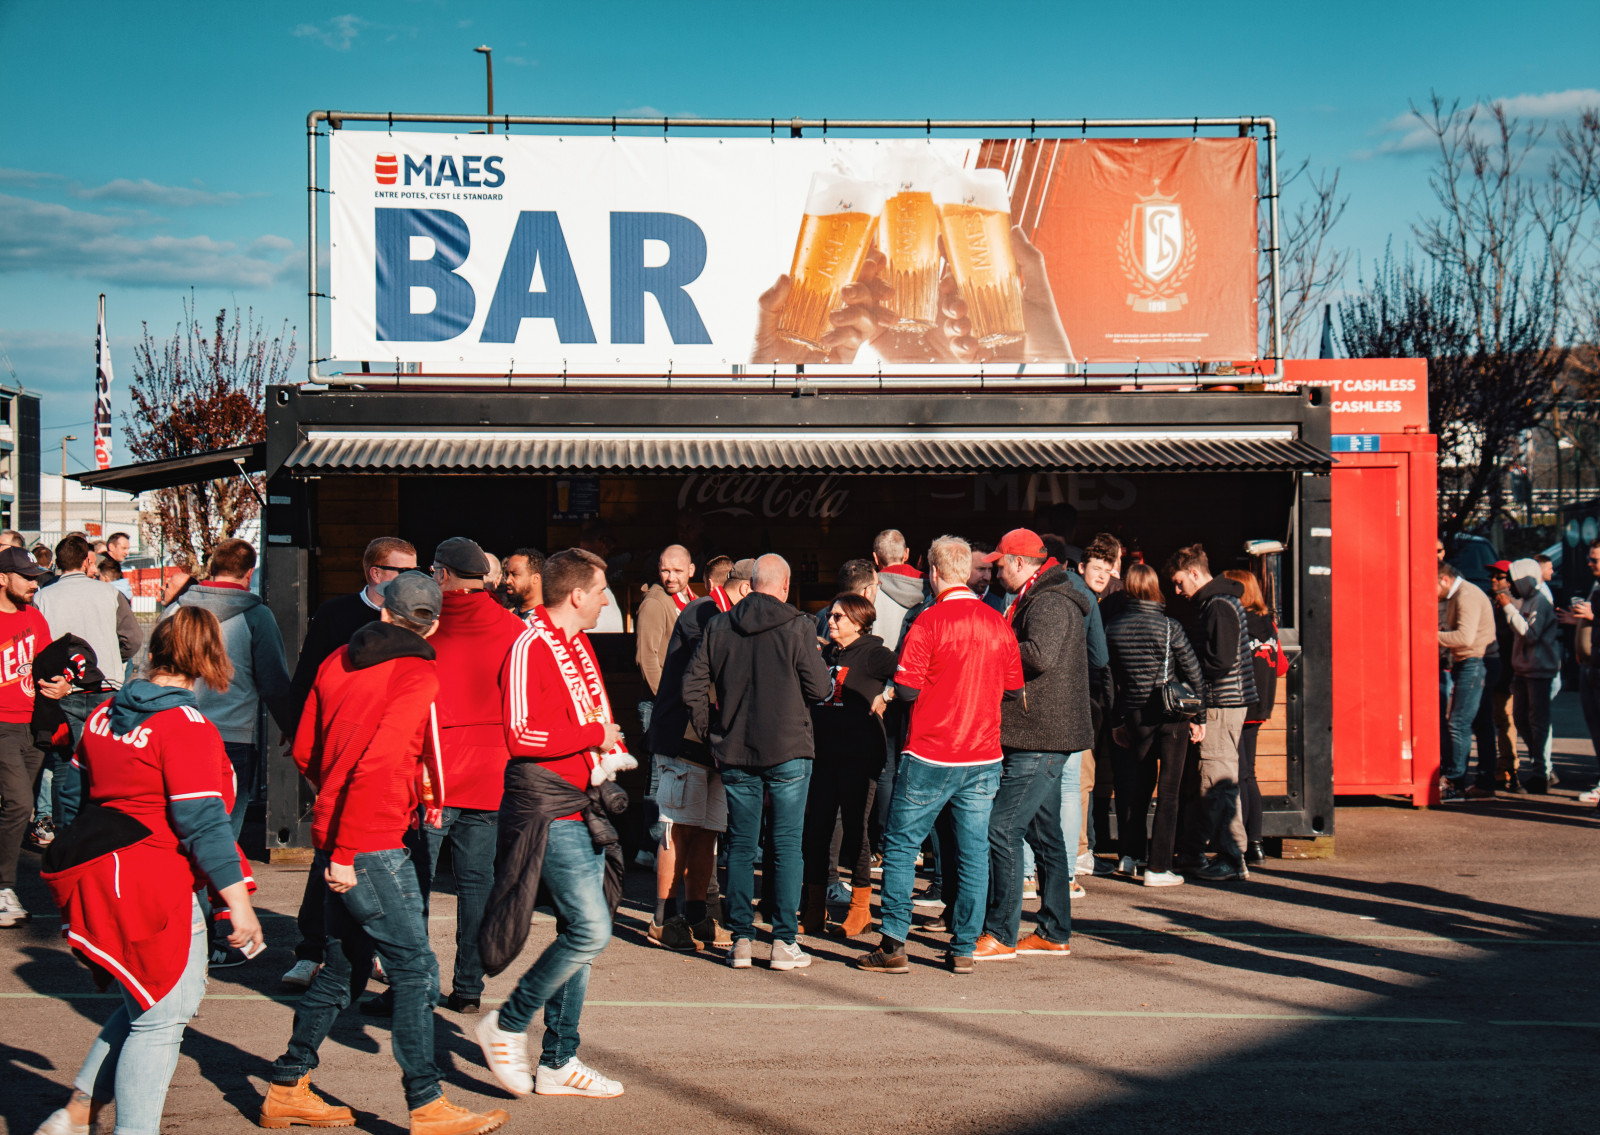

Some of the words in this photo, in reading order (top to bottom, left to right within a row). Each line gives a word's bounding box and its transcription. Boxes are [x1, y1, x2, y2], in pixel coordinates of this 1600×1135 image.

[404, 154, 506, 188] MAES
[375, 191, 399, 199] ENTRE
[401, 192, 428, 200] POTES,
[463, 193, 503, 201] STANDARD
[375, 207, 713, 345] BAR
[1343, 379, 1416, 392] CASHLESS
[1331, 400, 1402, 413] CASHLESS
[973, 472, 1137, 511] MAES
